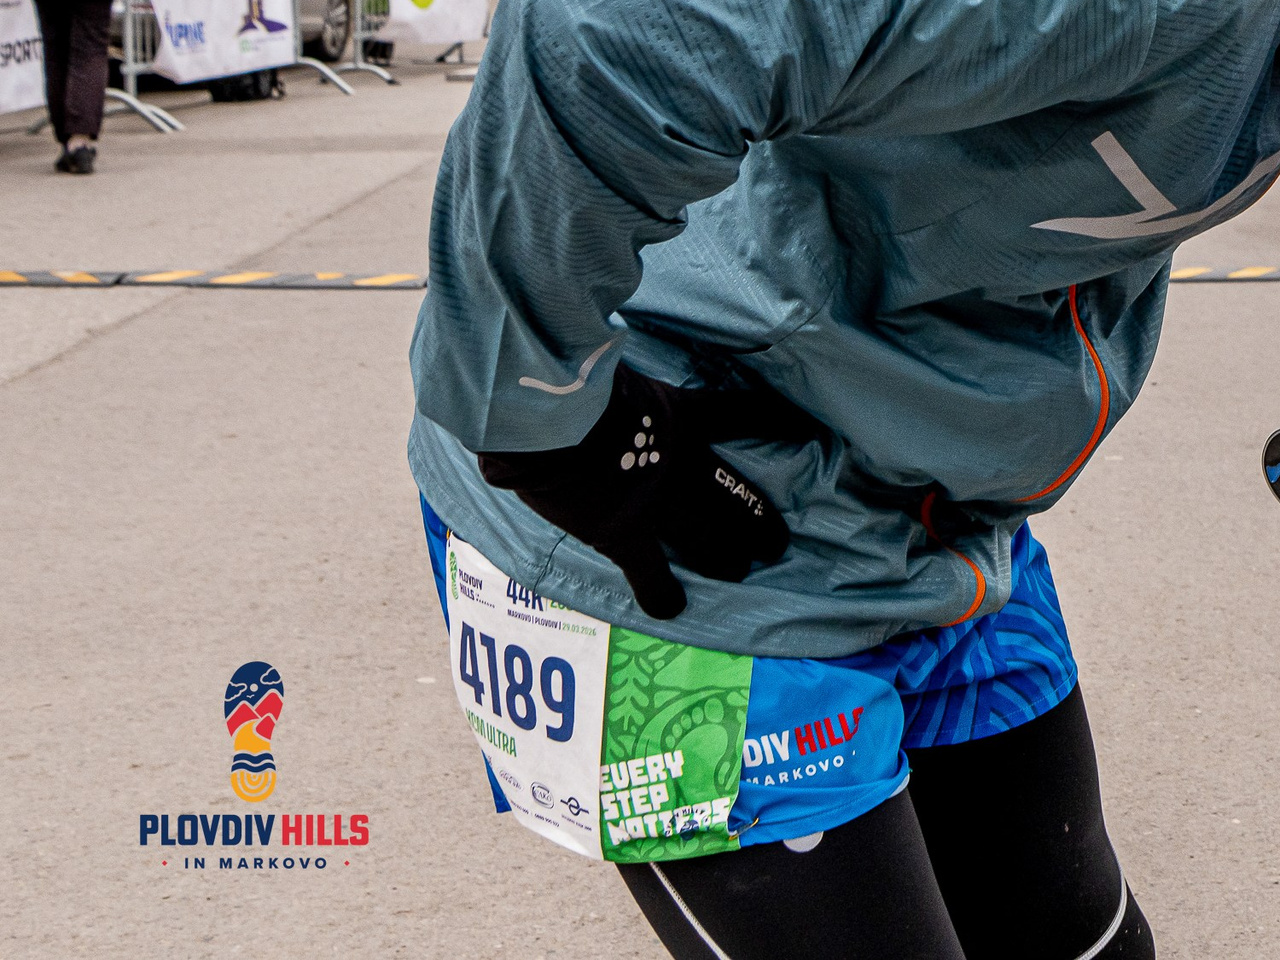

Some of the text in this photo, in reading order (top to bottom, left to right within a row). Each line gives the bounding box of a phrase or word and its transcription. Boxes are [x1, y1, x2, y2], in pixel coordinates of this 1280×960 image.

[458, 568, 483, 591] PLOVDIV
[459, 582, 475, 601] HILLS
[534, 616, 559, 629] PLOVDIV
[459, 620, 576, 743] 4189
[486, 722, 517, 758] ULTRA
[600, 750, 685, 794] EVERY
[601, 784, 670, 821] STEP
